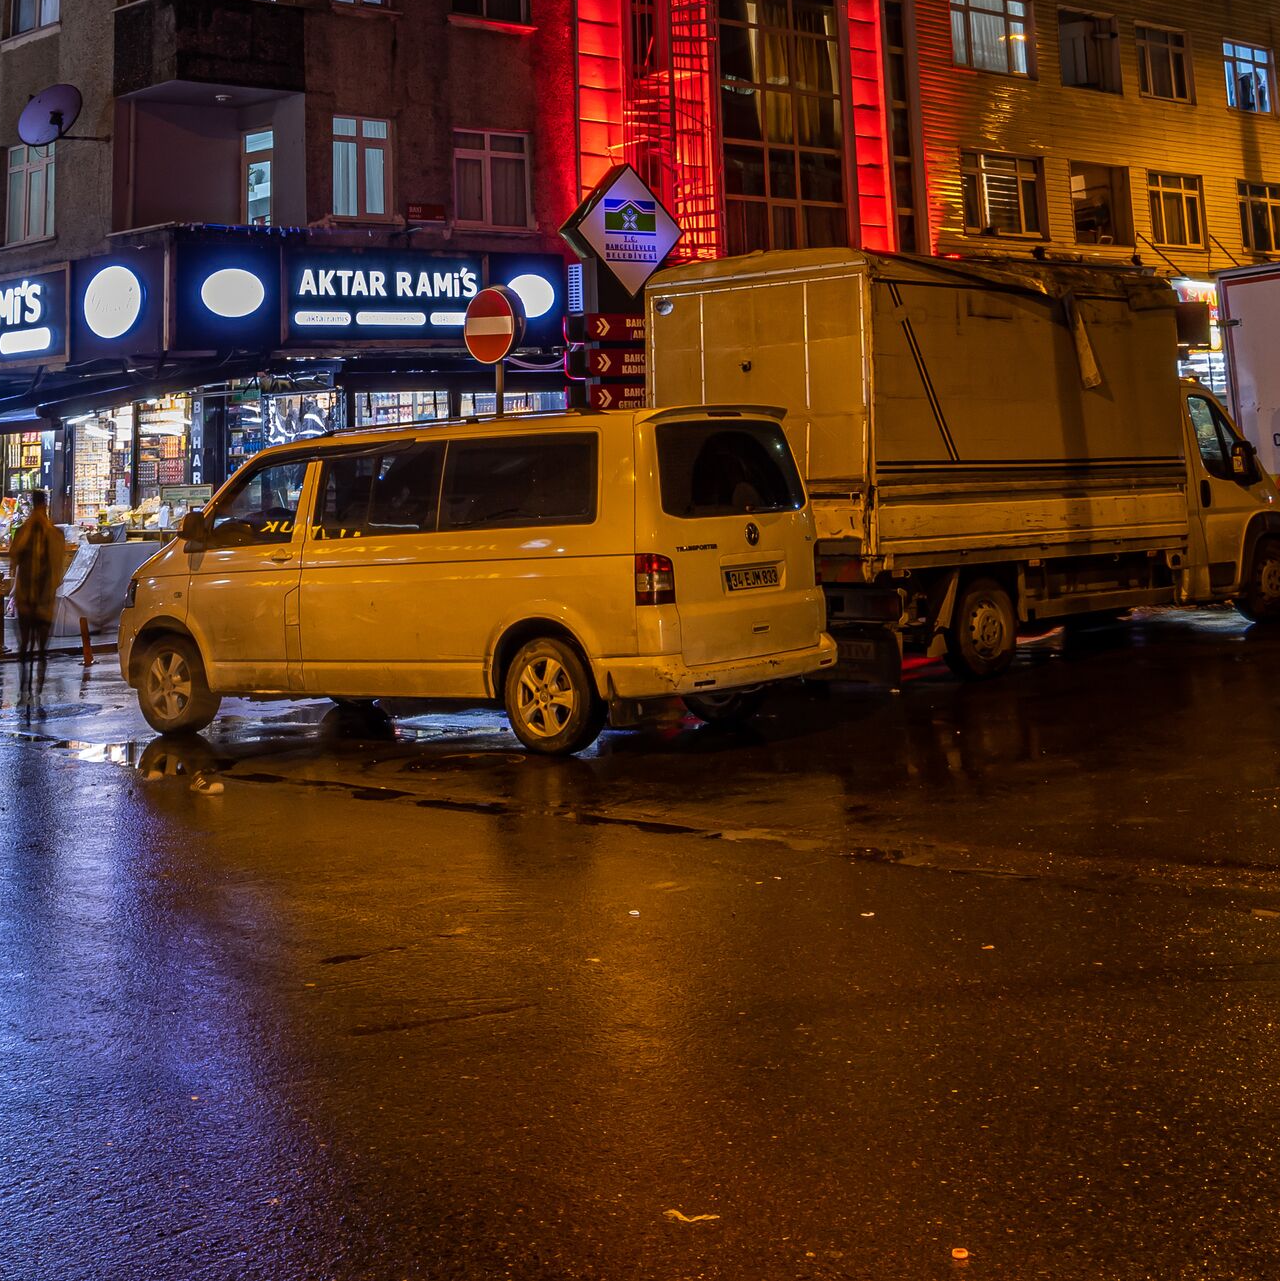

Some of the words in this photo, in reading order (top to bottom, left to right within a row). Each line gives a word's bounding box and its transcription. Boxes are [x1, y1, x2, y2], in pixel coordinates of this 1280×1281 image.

[298, 269, 387, 297] AKTAR
[624, 354, 646, 364] BAHÇ
[624, 388, 646, 398] BAHÇ
[192, 401, 202, 485] BAHAR
[675, 543, 718, 553] TRANSPORTER
[731, 573, 744, 588] 34
[762, 569, 778, 585] 833
